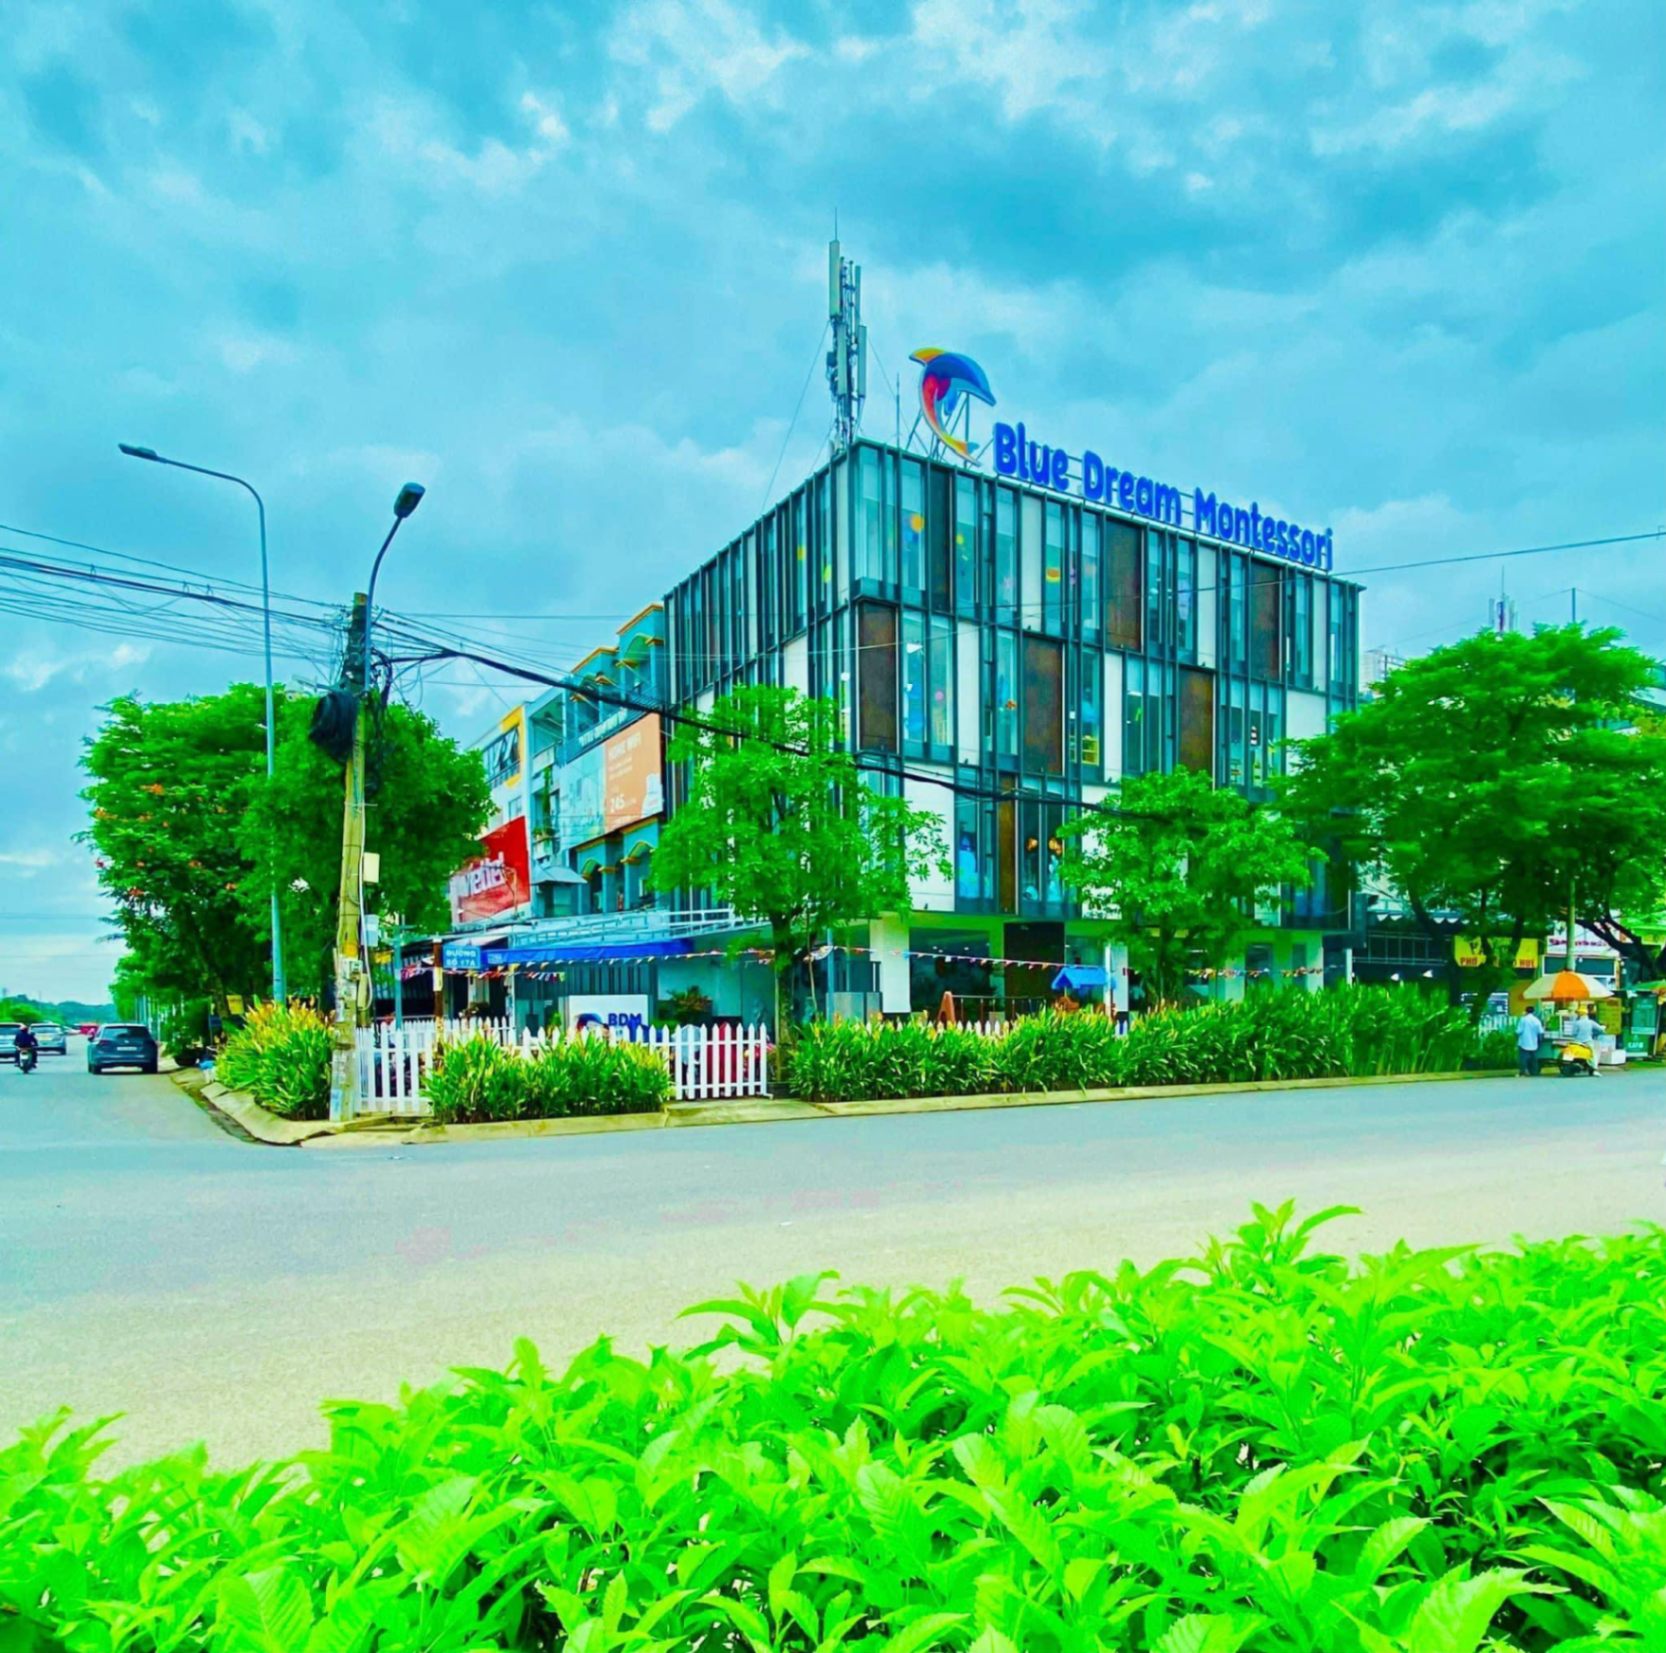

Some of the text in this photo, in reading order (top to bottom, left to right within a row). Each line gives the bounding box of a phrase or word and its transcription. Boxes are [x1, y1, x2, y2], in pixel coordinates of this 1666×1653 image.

[993, 421, 1333, 571] Blue Dream Montessori
[608, 1012, 642, 1026] BDM
